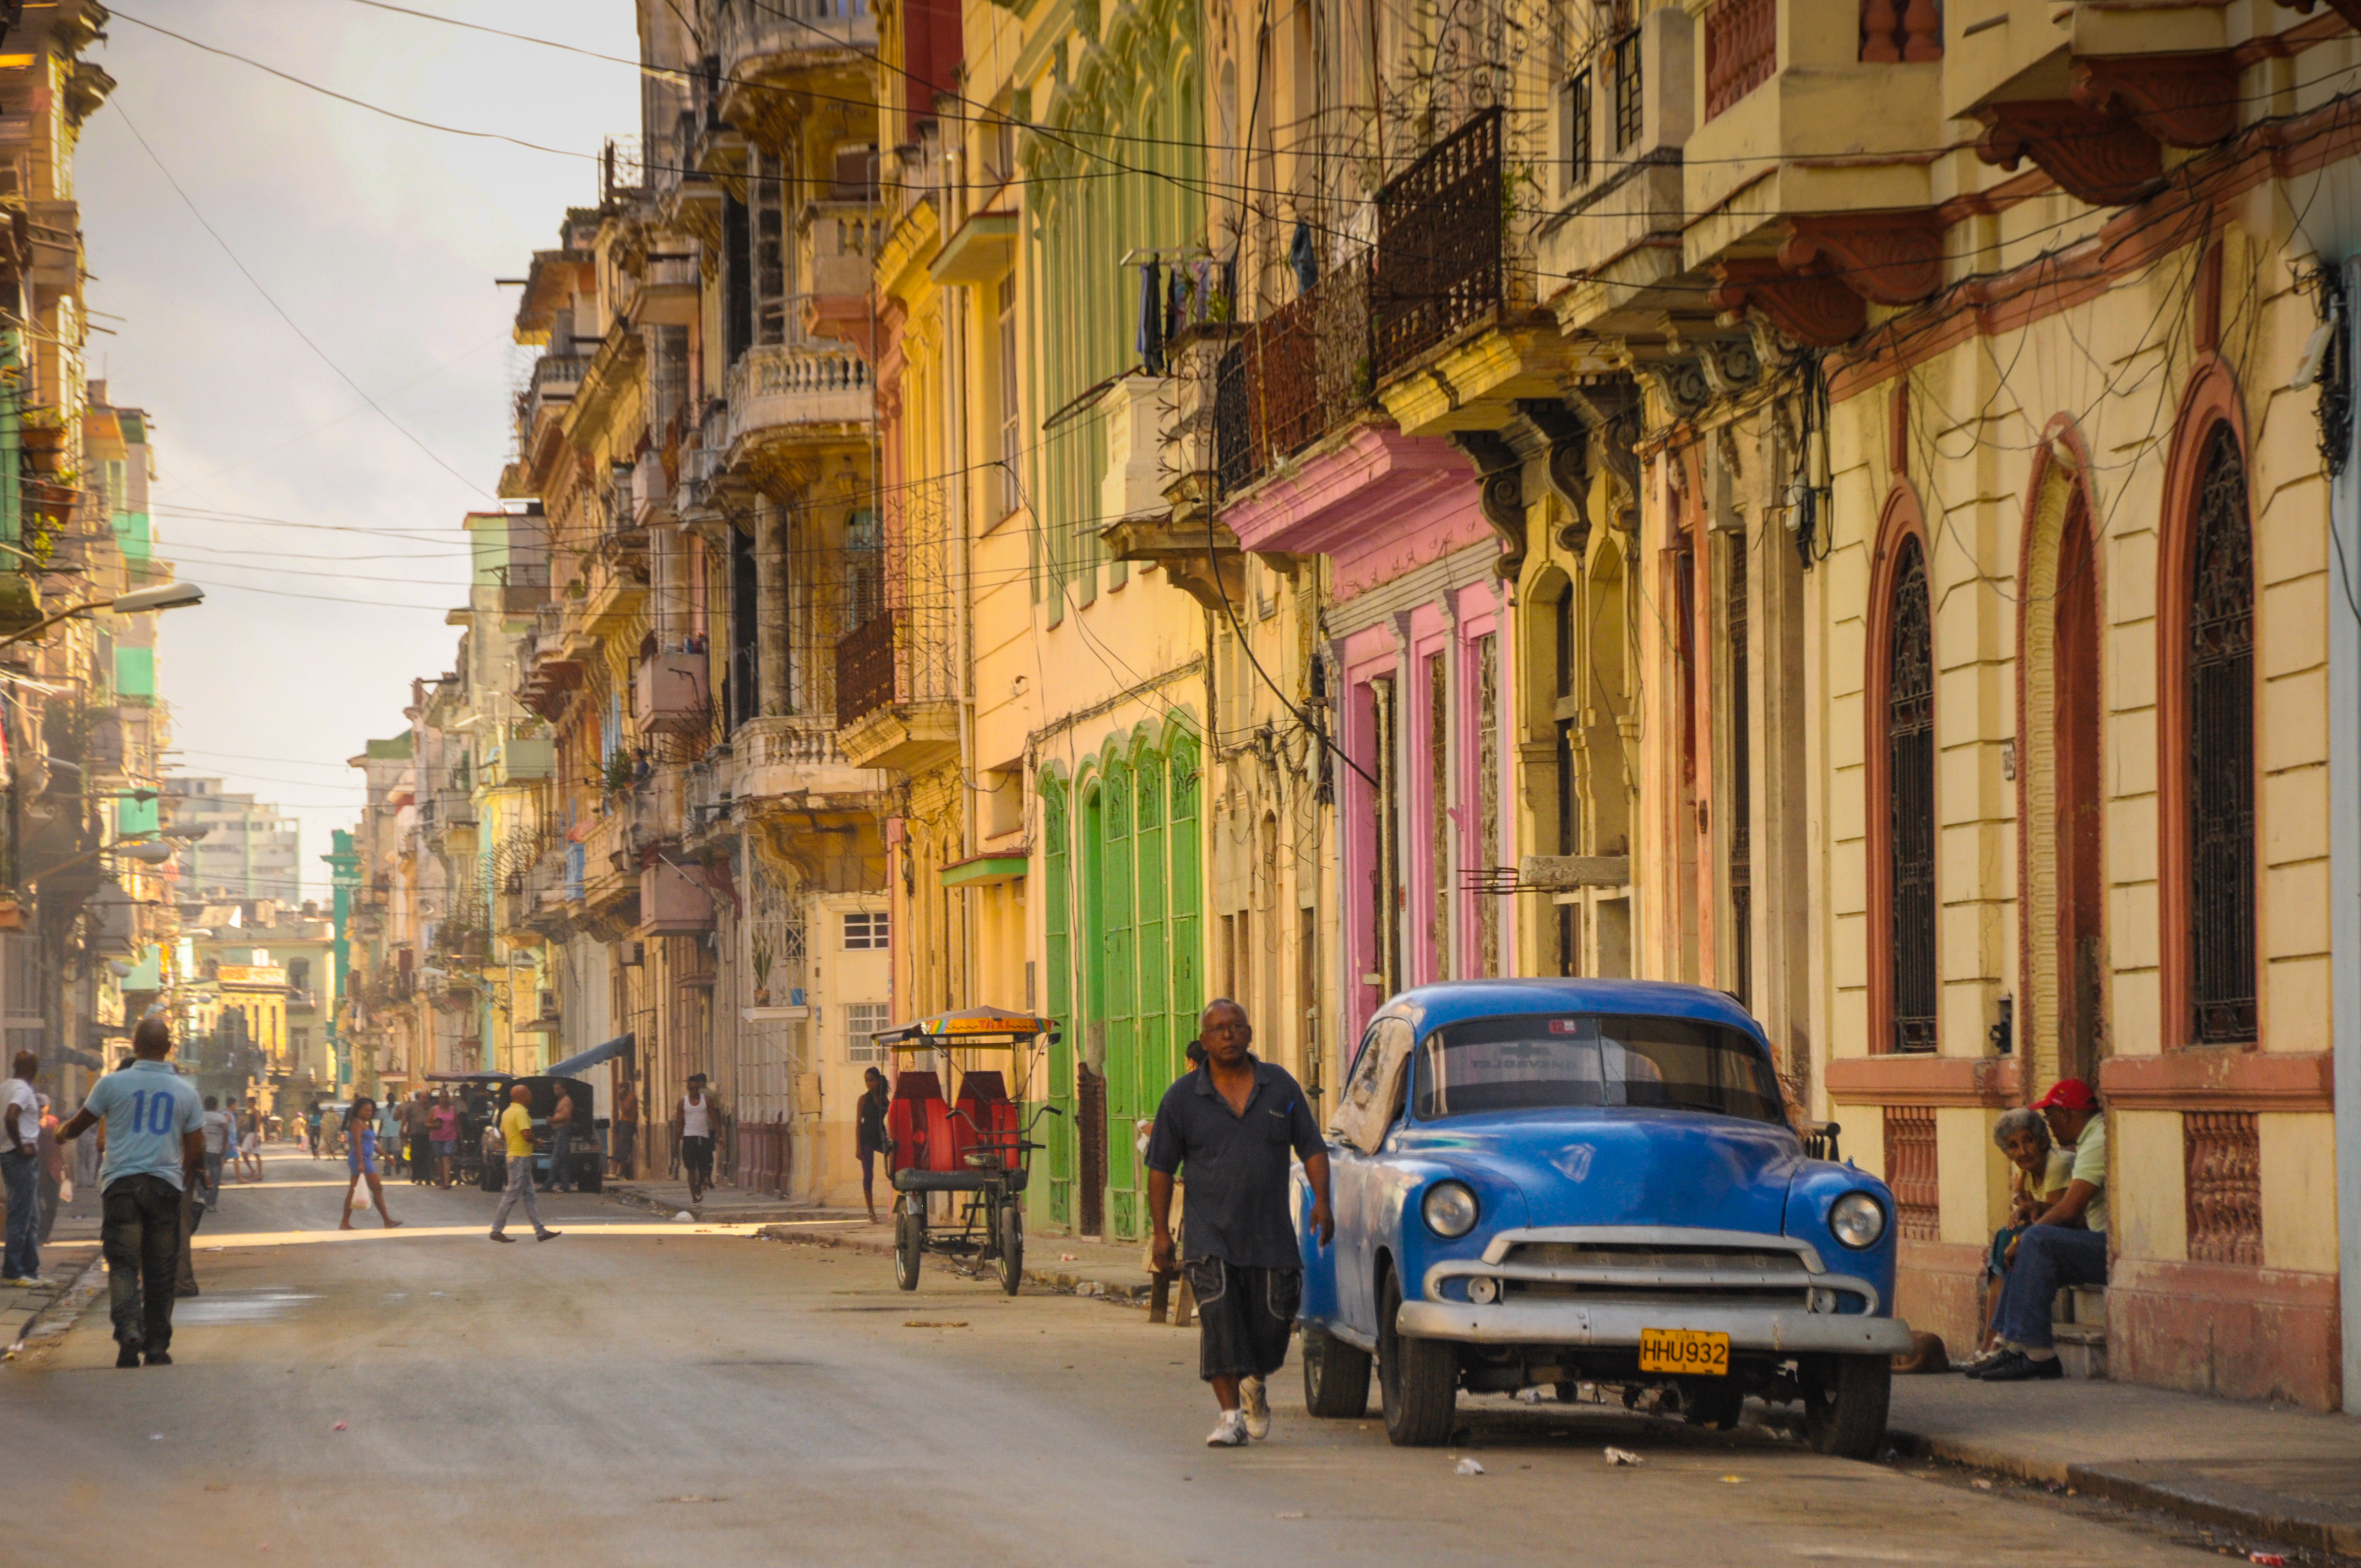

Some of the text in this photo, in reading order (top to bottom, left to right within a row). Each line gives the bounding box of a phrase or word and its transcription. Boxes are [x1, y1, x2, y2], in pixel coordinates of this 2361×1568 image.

[979, 1020, 1010, 1029] TAXI
[132, 1090, 175, 1136] 10
[1644, 1340, 1726, 1364] HHU932
